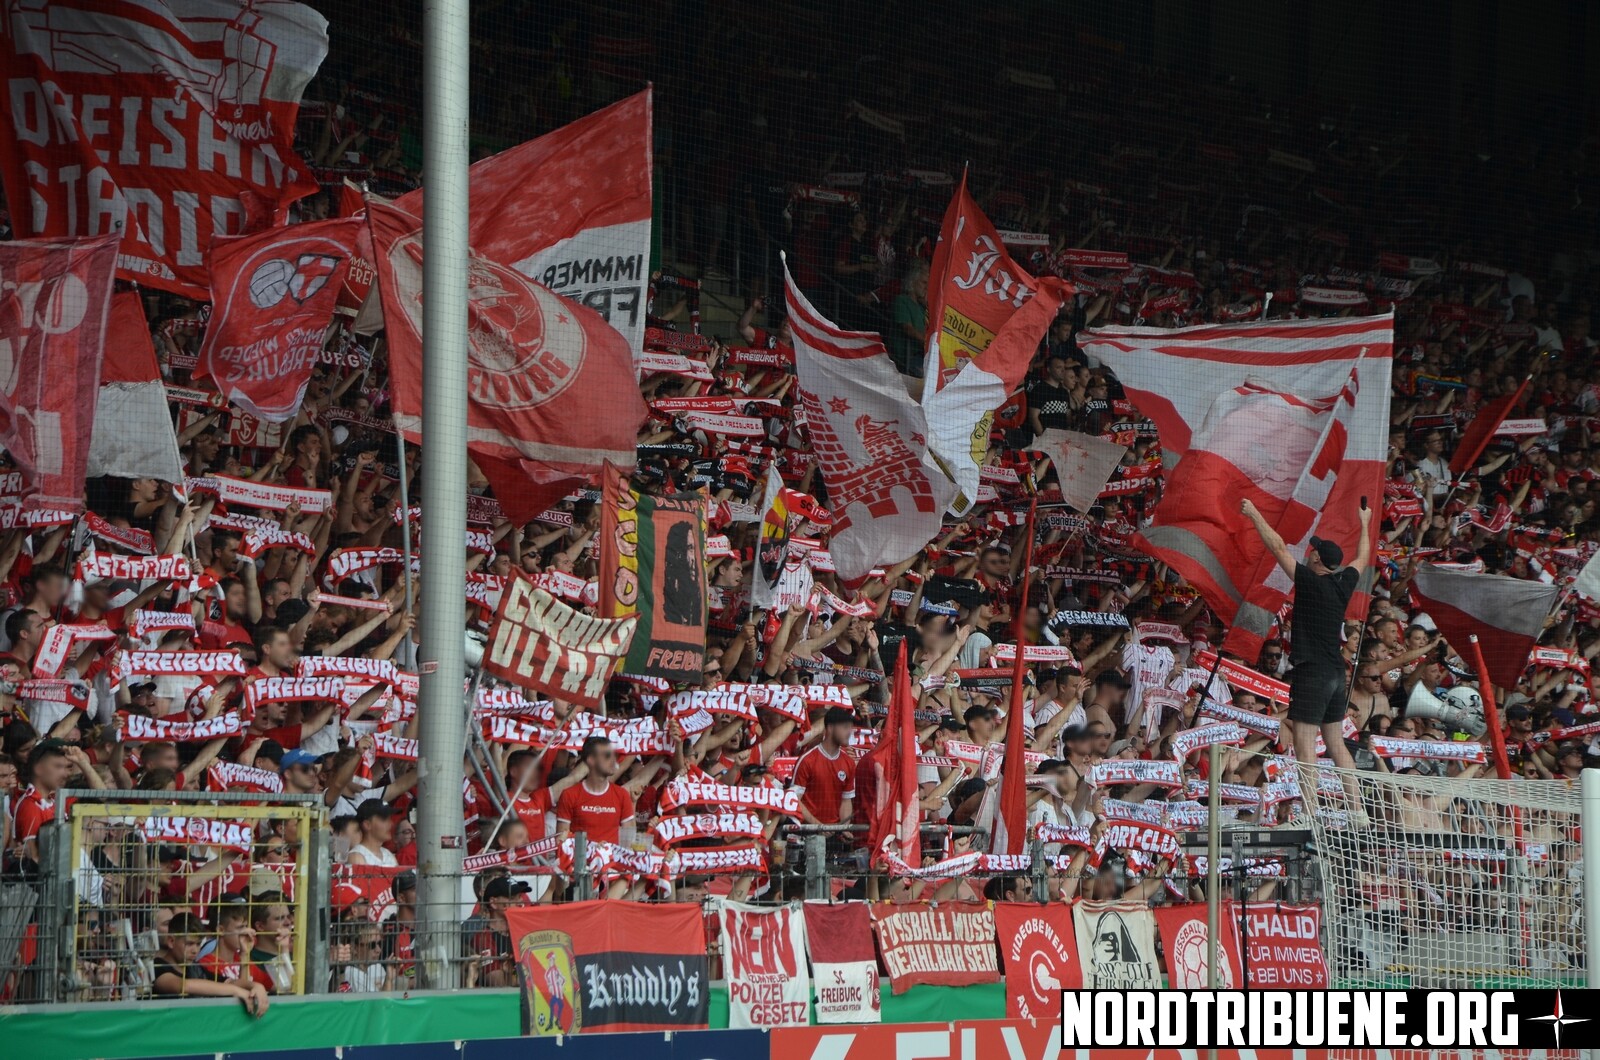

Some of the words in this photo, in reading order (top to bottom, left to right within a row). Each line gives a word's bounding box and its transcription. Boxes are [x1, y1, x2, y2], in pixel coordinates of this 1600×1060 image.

[490, 619, 612, 700] ULTRA
[375, 734, 419, 755] FREI
[689, 781, 799, 812] FREIBURG
[657, 814, 763, 841] ULTRAS
[725, 908, 797, 979] NEIN
[878, 911, 952, 950] FUSSBALL
[952, 911, 995, 943] MUSS
[1012, 918, 1069, 962] VIDEOBEWEIS
[1176, 923, 1202, 965] FUSSBALL
[964, 943, 998, 972] SEIN
[1275, 946, 1322, 964] IMMER
[584, 960, 700, 1016] Knaddly's
[1258, 967, 1279, 984] BEI
[1283, 967, 1313, 985] UNS
[731, 982, 784, 1005] POLIZEI
[821, 986, 862, 1004] FREIBURG
[750, 1001, 807, 1026] GESETZ
